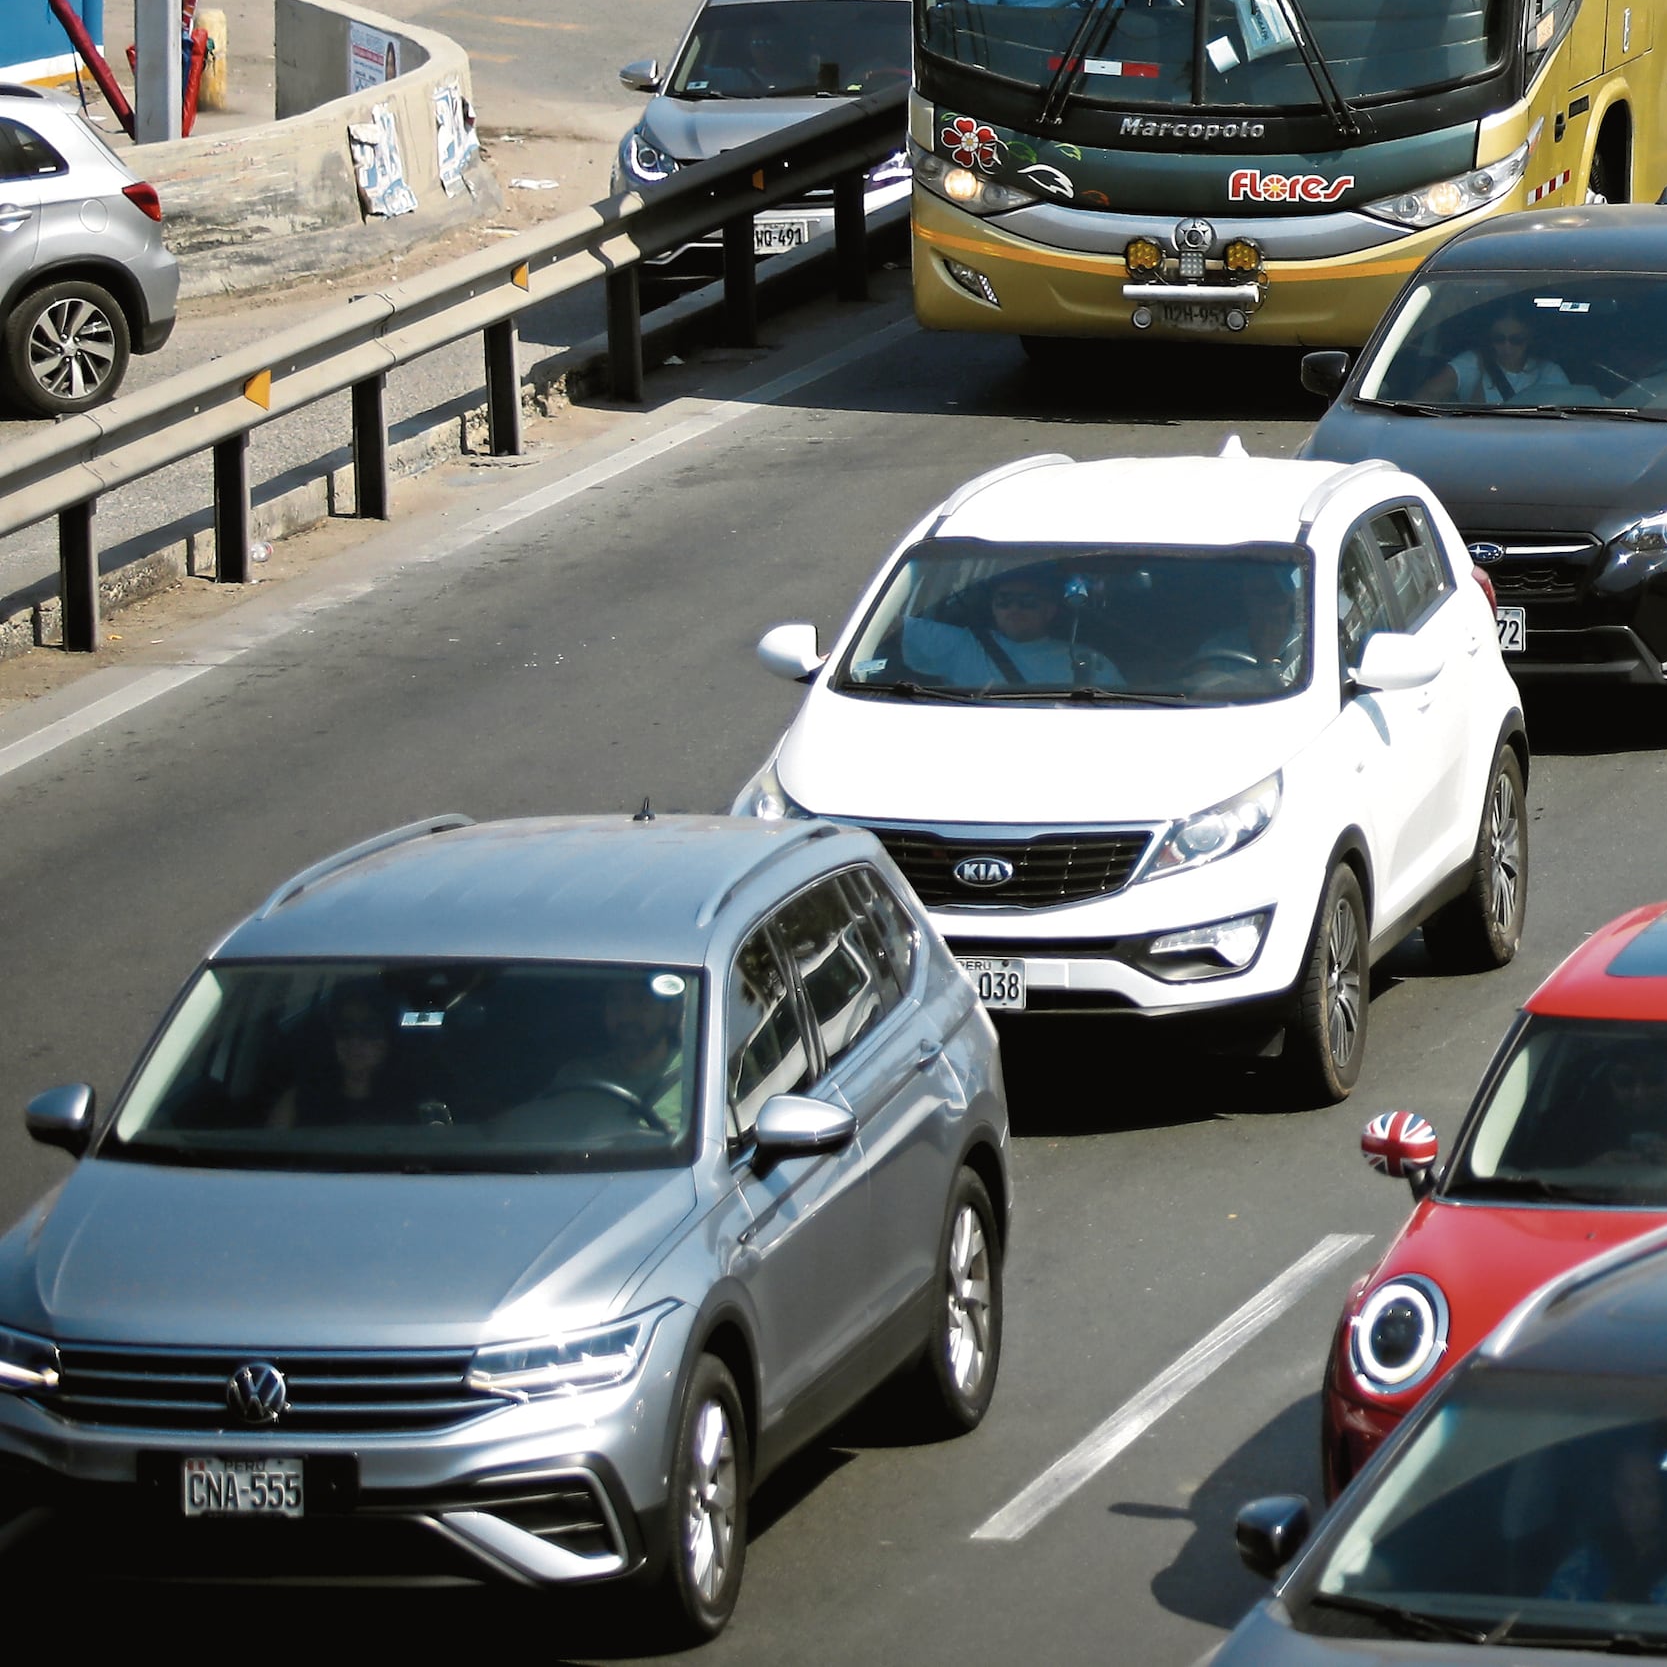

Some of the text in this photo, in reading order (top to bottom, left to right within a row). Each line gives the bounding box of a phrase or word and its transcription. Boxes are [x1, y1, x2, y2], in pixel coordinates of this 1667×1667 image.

[1120, 117, 1264, 140] Marcopolo
[755, 228, 803, 247] WQ-491
[960, 862, 1005, 881] KIA
[978, 972, 1020, 1001] 038
[224, 1460, 266, 1472] PERU
[190, 1471, 303, 1511] CNA-555
